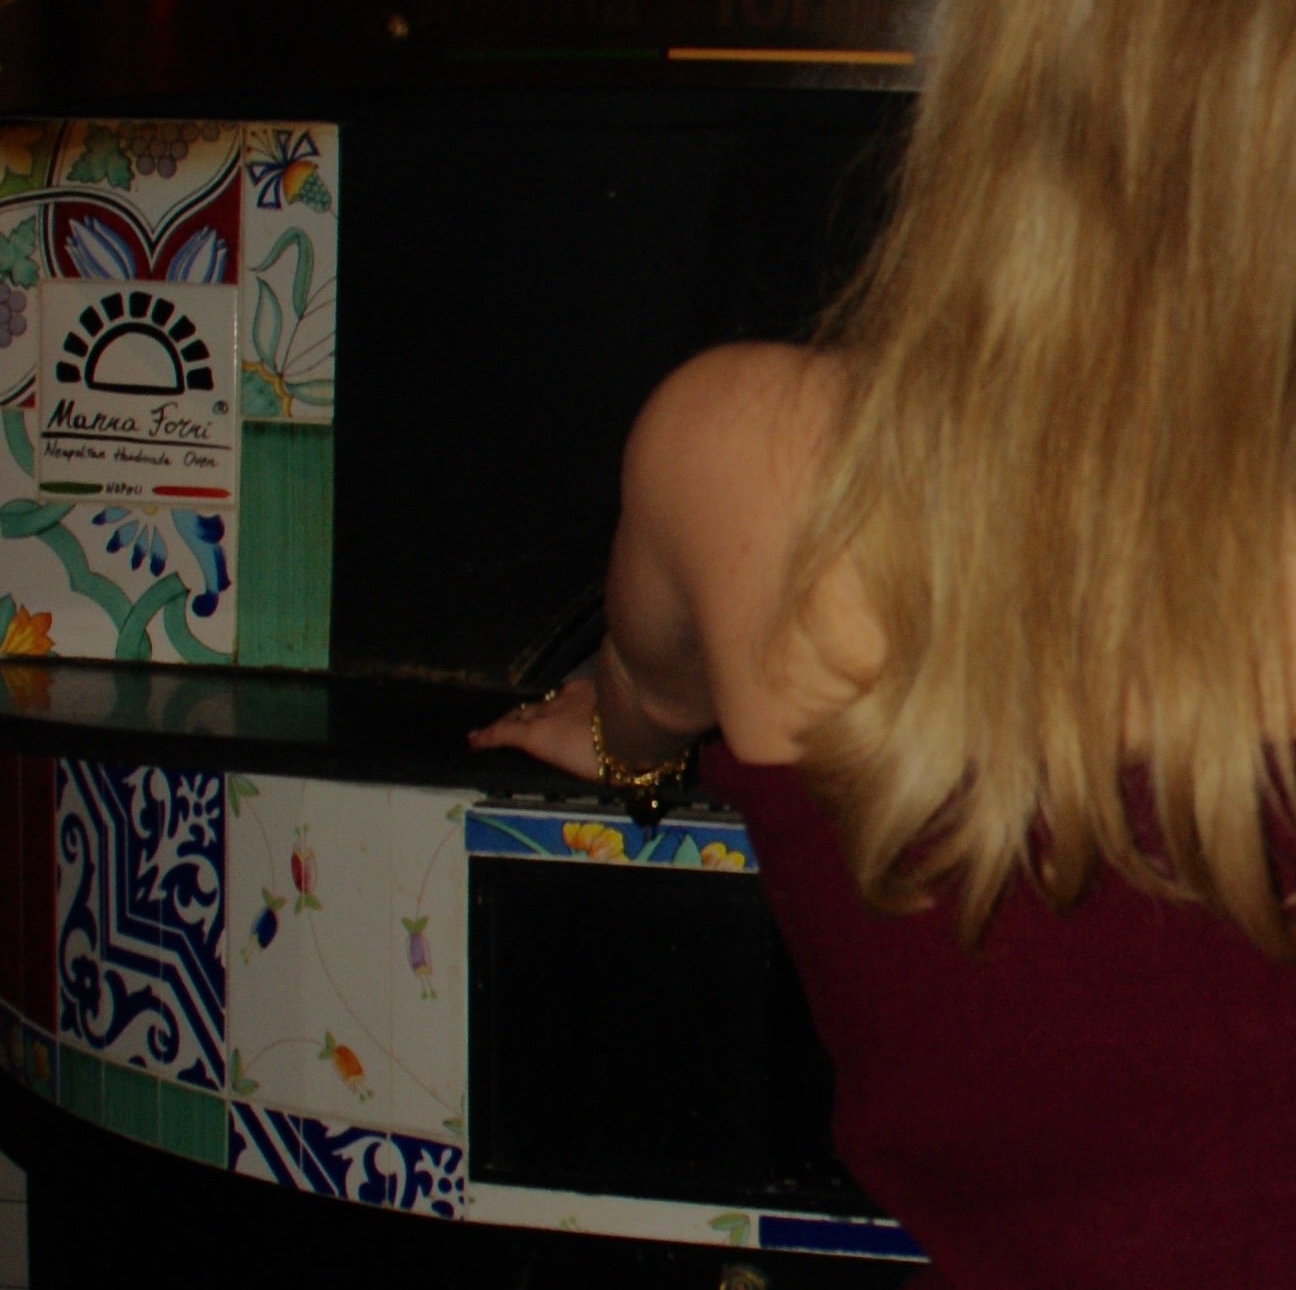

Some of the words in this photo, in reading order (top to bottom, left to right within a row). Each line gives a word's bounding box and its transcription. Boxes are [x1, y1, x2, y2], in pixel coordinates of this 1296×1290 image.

[48, 399, 138, 432] Manna
[149, 402, 210, 440] Forni
[184, 452, 217, 468] Oven
